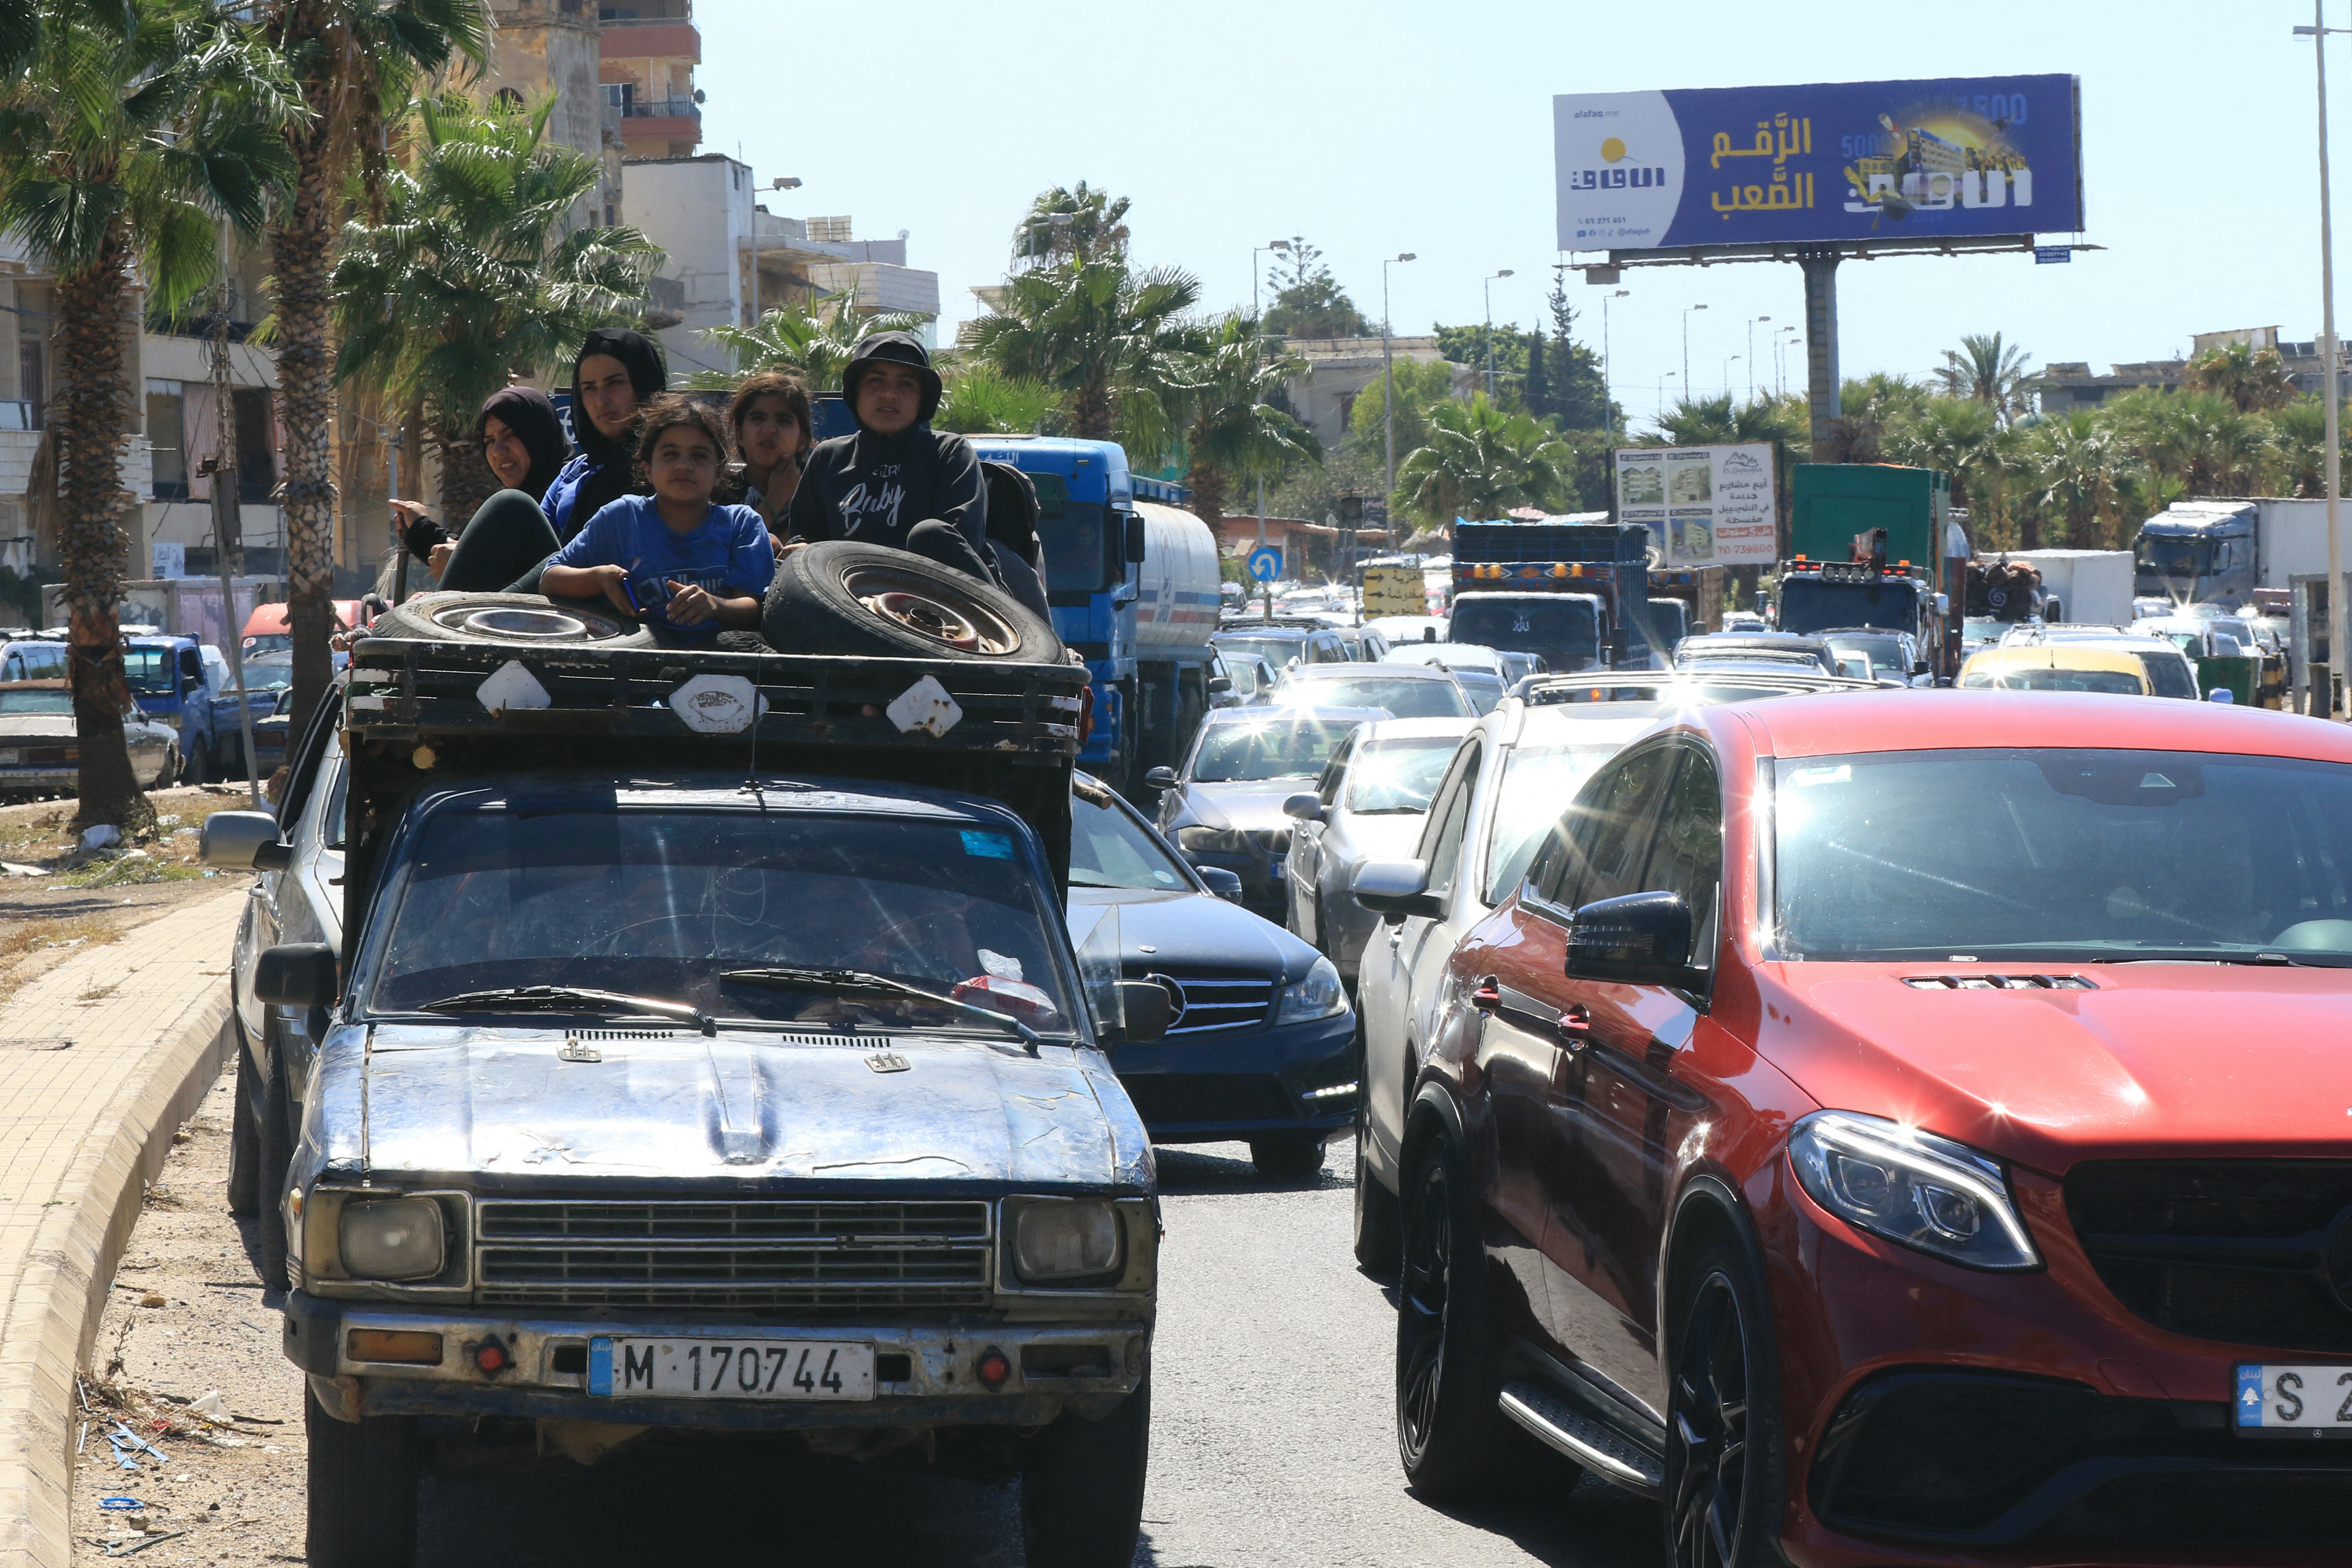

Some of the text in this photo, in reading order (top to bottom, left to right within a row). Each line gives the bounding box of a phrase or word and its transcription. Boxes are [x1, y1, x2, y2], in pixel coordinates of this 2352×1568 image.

[1574, 110, 1620, 118] alafaq.me
[1719, 477, 1767, 492] أربع مشاريع
[1759, 503, 1769, 513] في
[1749, 527, 1756, 537] 5
[1717, 545, 1730, 554] 70
[592, 1342, 611, 1352] لبنان
[624, 1345, 842, 1393] M 170744
[2239, 1369, 2261, 1380] لبنان
[2276, 1373, 2303, 1421] S
